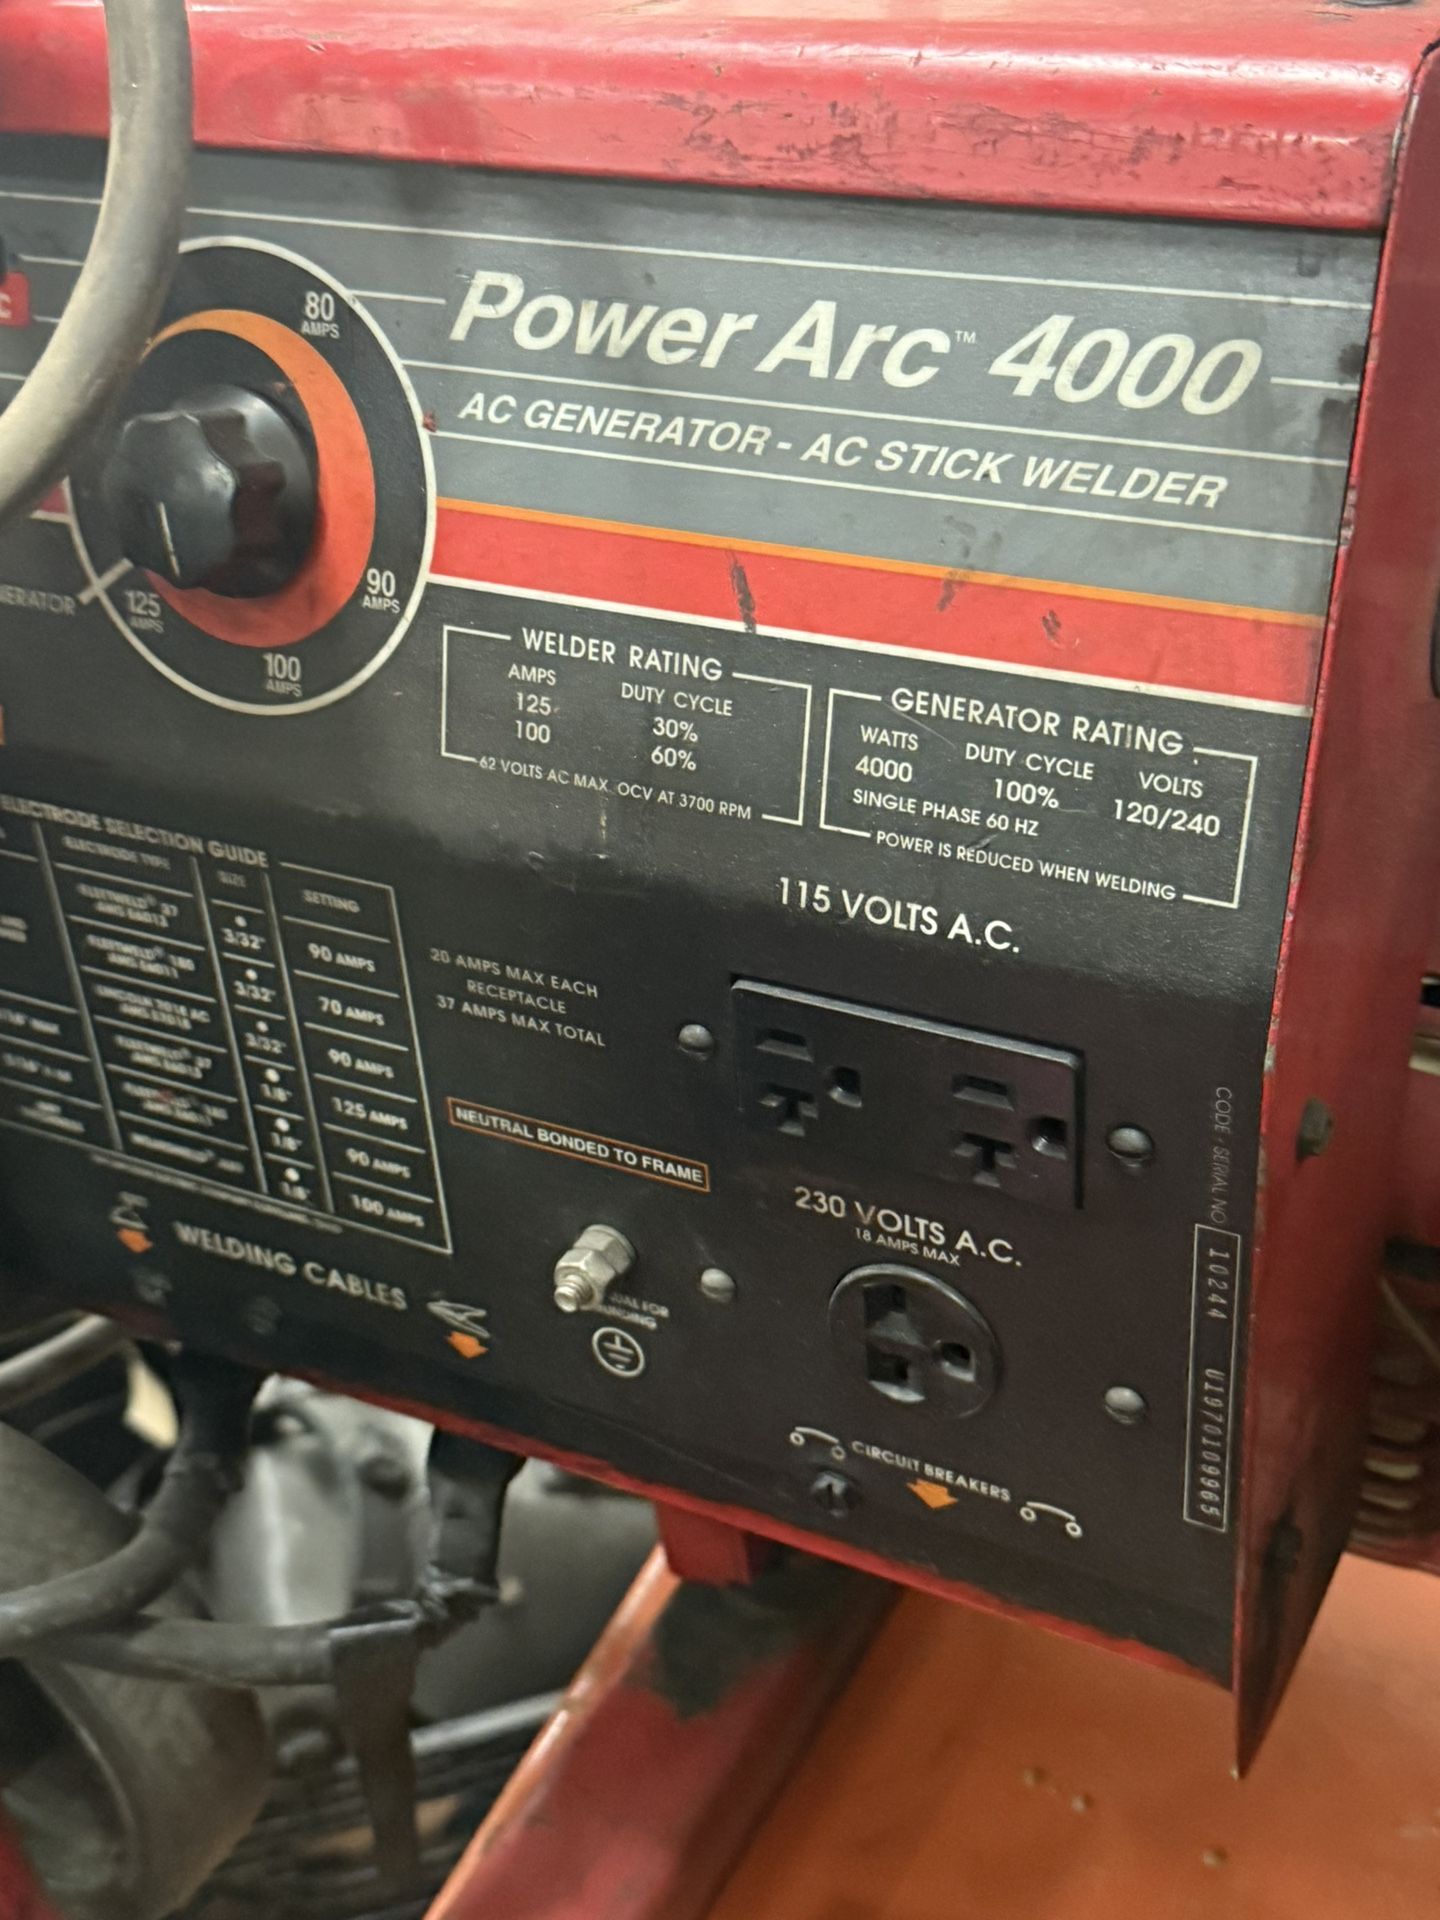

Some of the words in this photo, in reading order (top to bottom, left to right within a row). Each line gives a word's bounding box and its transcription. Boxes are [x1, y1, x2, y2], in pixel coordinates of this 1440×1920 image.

[305, 291, 334, 322] 80
[302, 321, 340, 340] AMPS
[449, 269, 758, 368] Power
[754, 300, 950, 388] Arc
[988, 314, 1262, 415] 4000
[458, 392, 517, 423] AC
[523, 399, 772, 456] GENERATOR
[801, 434, 868, 467] AC
[875, 440, 1015, 485] STICK
[1022, 456, 1228, 509] WELDER
[366, 568, 396, 597] 90
[124, 589, 161, 618] 125
[362, 594, 400, 614] AMPS
[262, 653, 301, 682] 100
[522, 627, 616, 664] WELDER
[629, 645, 722, 682] RATING
[266, 680, 302, 698] AMPS
[508, 663, 556, 686] AMPS
[515, 692, 551, 716] 125
[621, 682, 665, 704] DUTY
[673, 691, 733, 717] CYCLE
[515, 720, 550, 744] 100
[652, 716, 698, 743] 30%
[860, 724, 919, 751] WATTS
[891, 687, 1061, 737] GENERATOR
[1072, 719, 1183, 757] RATING
[650, 746, 697, 772] 60%
[855, 754, 913, 784] 4000
[965, 742, 1016, 767] DUTY
[1026, 753, 1094, 781] CYCLE
[479, 756, 496, 772] 62
[500, 759, 543, 781] VOLTS
[547, 769, 570, 785] AC
[617, 781, 653, 801] OCV
[657, 790, 675, 805] AT
[679, 793, 715, 813] 3700
[718, 801, 752, 820] RPM
[993, 778, 1059, 810] 100%
[1138, 771, 1203, 798] VOLTS
[853, 788, 917, 814] SINGLE
[922, 800, 981, 826] PHASE
[986, 813, 1009, 832] 60
[1014, 817, 1039, 837] HZ
[1113, 798, 1221, 838] 120/240
[208, 841, 269, 868] GUIDE
[876, 830, 933, 855] POWER
[938, 841, 952, 858] IS
[956, 845, 1034, 874] REDUCED
[1038, 860, 1089, 885] WHEN
[1095, 871, 1176, 901] WELDING
[303, 889, 360, 914] SETTING
[780, 877, 831, 913] 115
[841, 889, 938, 935] VOLTS
[947, 913, 1019, 953] A.C.
[308, 942, 332, 962] 90
[335, 953, 376, 973] AMPS
[430, 947, 450, 964] 20
[455, 954, 501, 976] AMPS
[505, 965, 545, 985] MAX
[550, 975, 598, 999] EACH
[318, 996, 342, 1015] 70
[345, 1006, 385, 1026] AMPS
[466, 979, 567, 1014] RECEPTACLE
[436, 994, 456, 1010] 37
[461, 1001, 507, 1023] AMPS
[511, 1012, 551, 1034] MAX
[554, 1023, 606, 1047] TOTAL
[328, 1048, 353, 1068] 90
[354, 1058, 395, 1079] AMPS
[332, 1097, 367, 1119] 125
[368, 1110, 408, 1131] AMPS
[1214, 1086, 1233, 1134] CODE
[346, 1147, 370, 1167] 90
[455, 1106, 533, 1139] NEUTRAL
[537, 1128, 610, 1159] BONDED
[612, 1147, 637, 1166] TO
[642, 1155, 704, 1183] FRAME
[1211, 1144, 1230, 1195] SERIAL
[794, 1186, 846, 1219] 230
[855, 1201, 946, 1246] VOLTS
[955, 1230, 1022, 1267] A.C.
[855, 1227, 871, 1242] 18
[875, 1234, 919, 1255] AMPS
[923, 1246, 961, 1267] MAX
[172, 1221, 297, 1276] WELDING
[303, 1261, 408, 1311] CABLES
[1205, 1248, 1230, 1319] 10244
[852, 1441, 920, 1472] CIRCUIT
[924, 1463, 1011, 1502] BREAKERS
